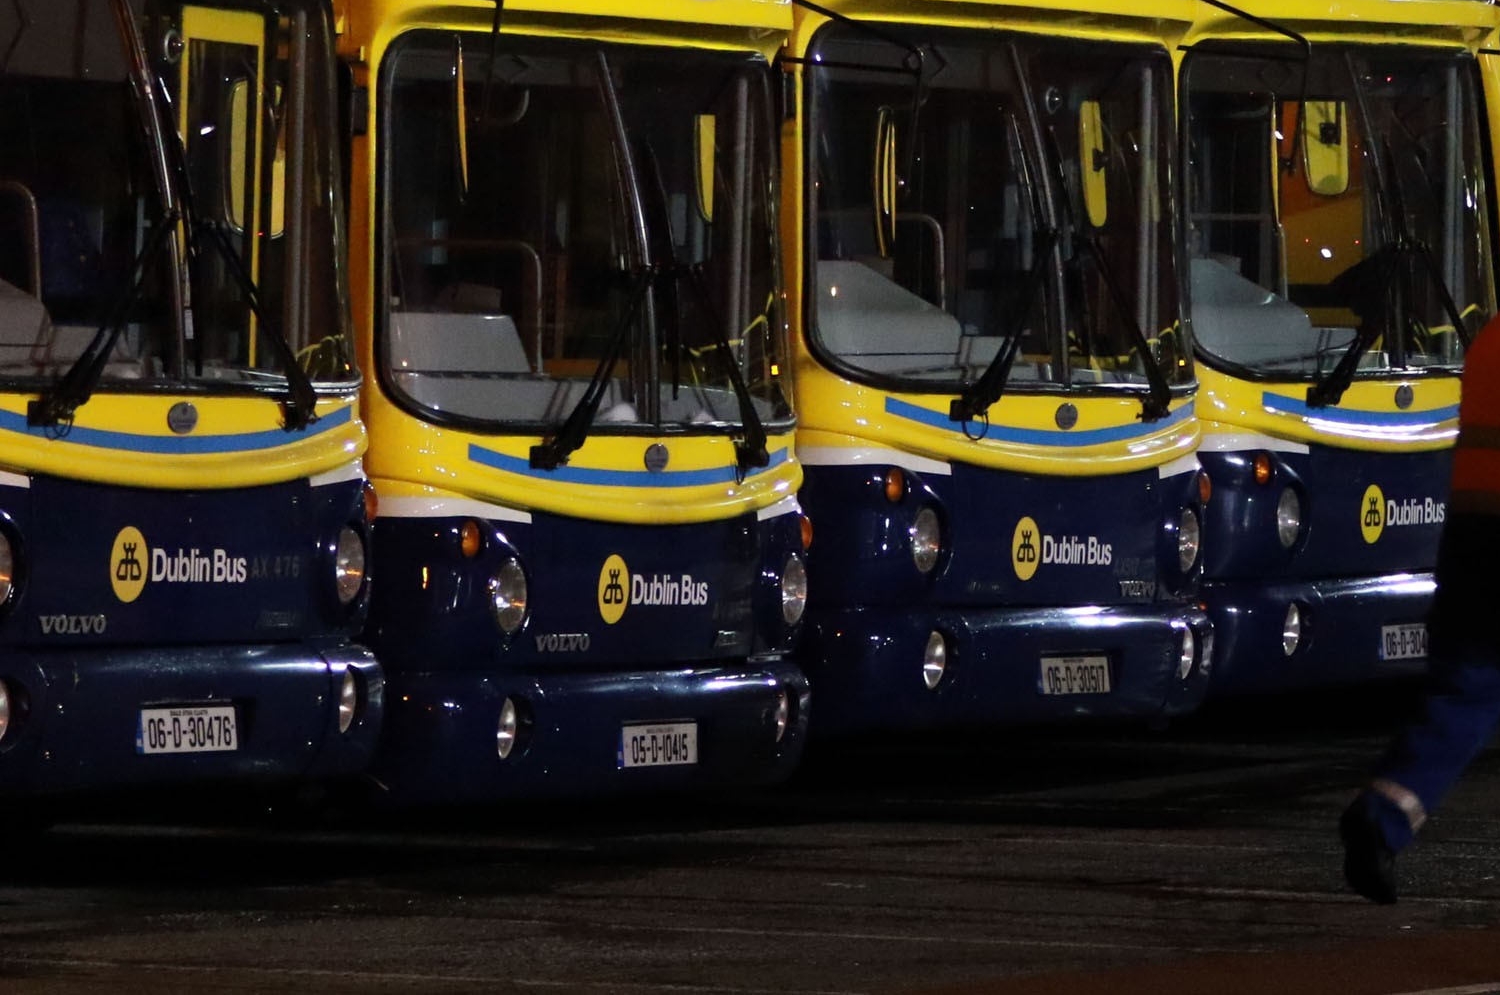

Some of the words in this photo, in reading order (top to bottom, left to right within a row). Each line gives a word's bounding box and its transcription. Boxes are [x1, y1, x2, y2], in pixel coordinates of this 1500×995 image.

[1386, 499, 1424, 526] Dublin
[1424, 497, 1445, 524] Bus
[1042, 534, 1087, 565] Dublin
[1087, 535, 1112, 566] Bus
[151, 548, 211, 583] Dublin
[213, 548, 248, 584] Bus
[631, 574, 680, 605] Dublin
[681, 574, 708, 606] Bus
[38, 614, 107, 634] VOLVO
[535, 633, 591, 652] VOLVO
[1047, 665, 1105, 694] 06-D-30517
[148, 716, 232, 749] 06-D-30476
[632, 733, 688, 764] 05-D-10415
